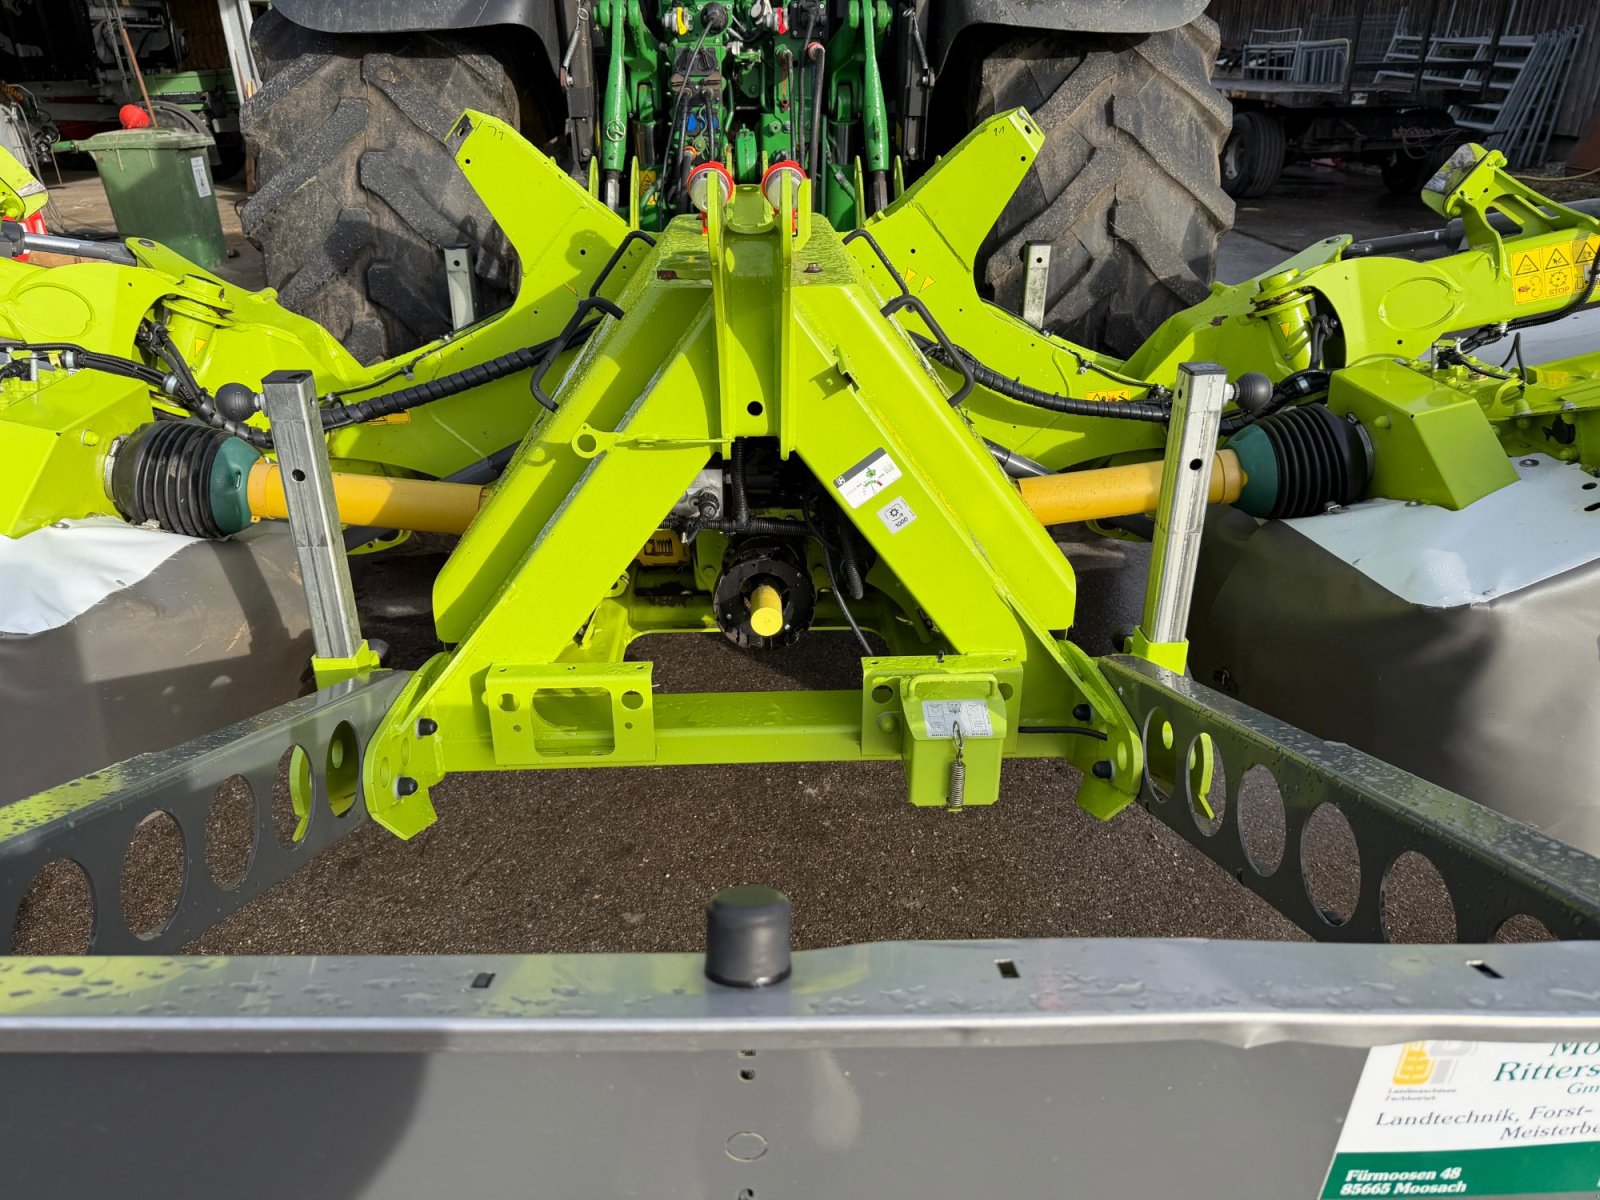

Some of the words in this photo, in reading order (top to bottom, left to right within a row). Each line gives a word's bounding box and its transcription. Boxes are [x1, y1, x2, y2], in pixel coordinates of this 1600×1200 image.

[1548, 286, 1570, 296] STOP
[895, 516, 908, 527] 1000
[1494, 1061, 1600, 1082] Ritters
[1376, 1108, 1520, 1126] Landtechnik,
[1529, 1105, 1593, 1120] Forst-
[1345, 1169, 1437, 1182] Fürmoosen
[1440, 1167, 1463, 1180] 48
[1340, 1182, 1392, 1195] 85665
[1393, 1180, 1467, 1194] Moosach
